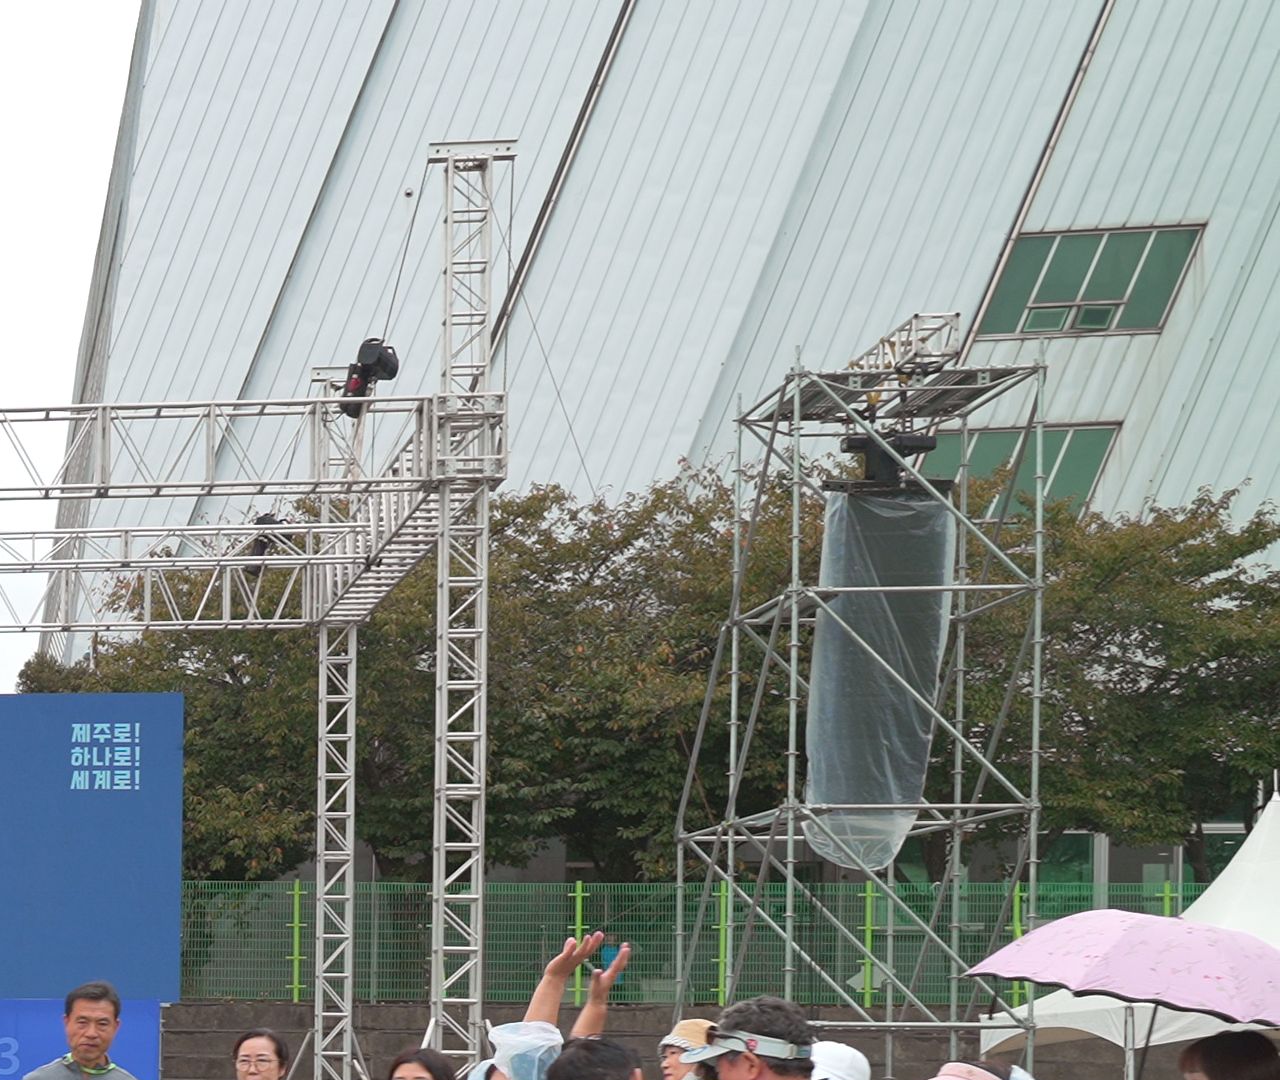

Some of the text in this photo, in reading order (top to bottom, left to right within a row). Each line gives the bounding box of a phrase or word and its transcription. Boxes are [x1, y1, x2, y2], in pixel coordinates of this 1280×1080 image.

[71, 722, 140, 743] 제주로!
[71, 746, 140, 767] 하나로!
[70, 769, 140, 790] 세계로!
